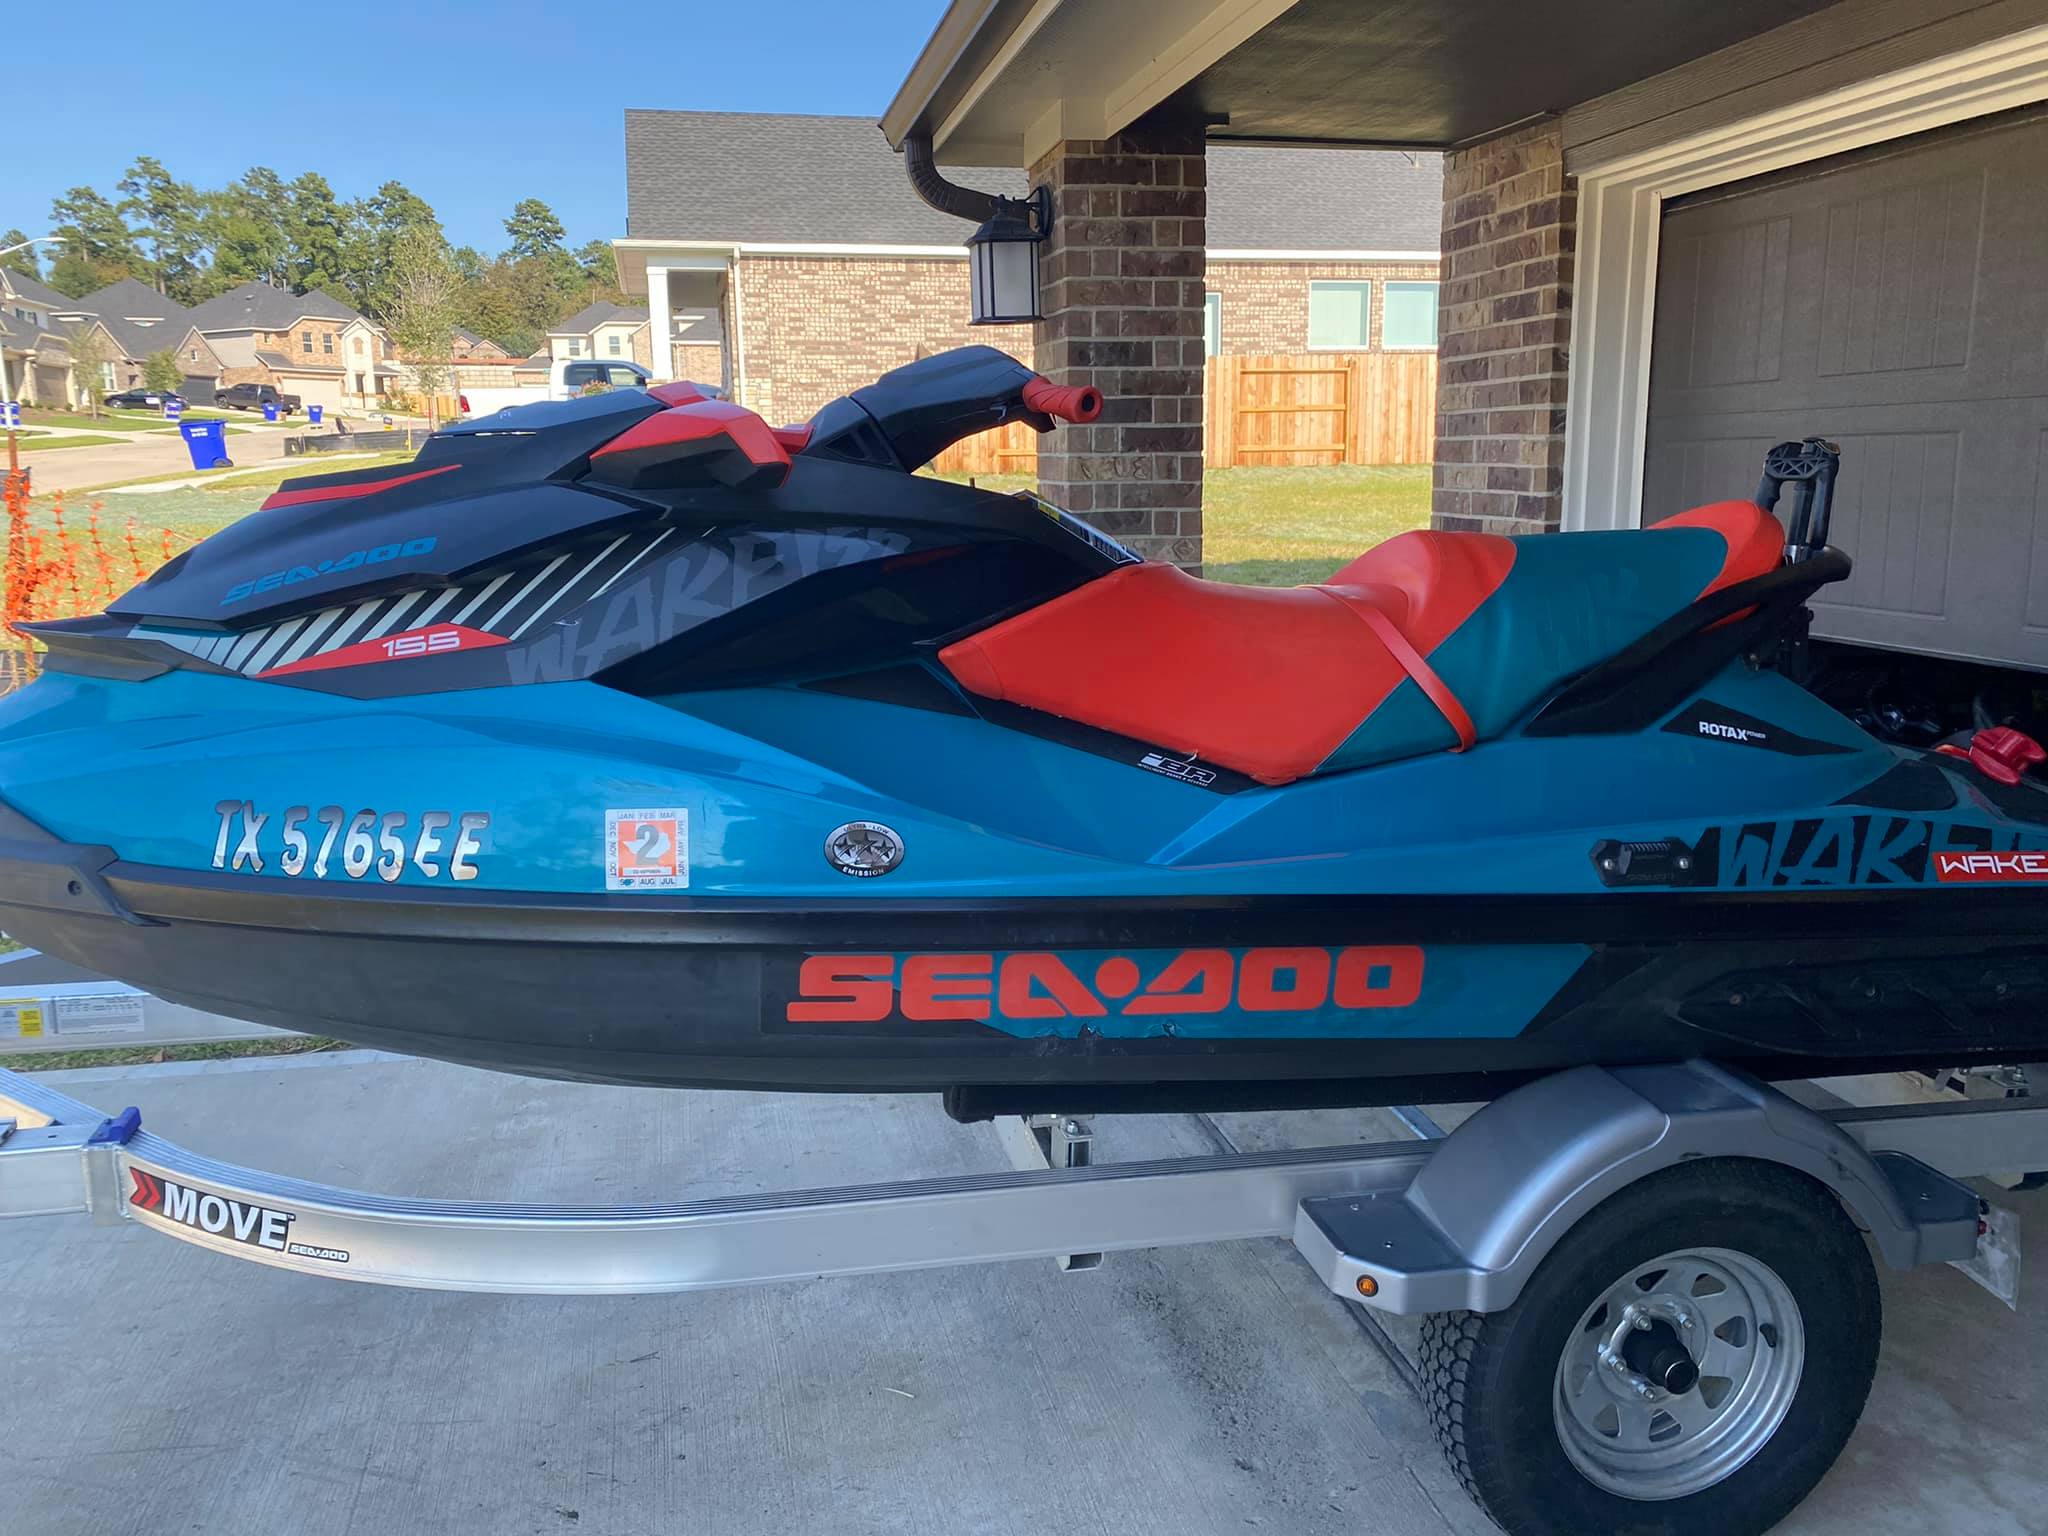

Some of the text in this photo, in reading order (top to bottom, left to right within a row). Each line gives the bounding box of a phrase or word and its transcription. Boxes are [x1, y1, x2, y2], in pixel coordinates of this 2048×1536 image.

[382, 631, 460, 657] 155
[1699, 721, 1748, 741] ROTAX
[211, 800, 491, 882] TX 5765 EE
[635, 824, 659, 865] 2
[842, 866, 885, 876] EMISSION
[1940, 854, 2048, 874] WAKE
[163, 1181, 288, 1249] MOVE
